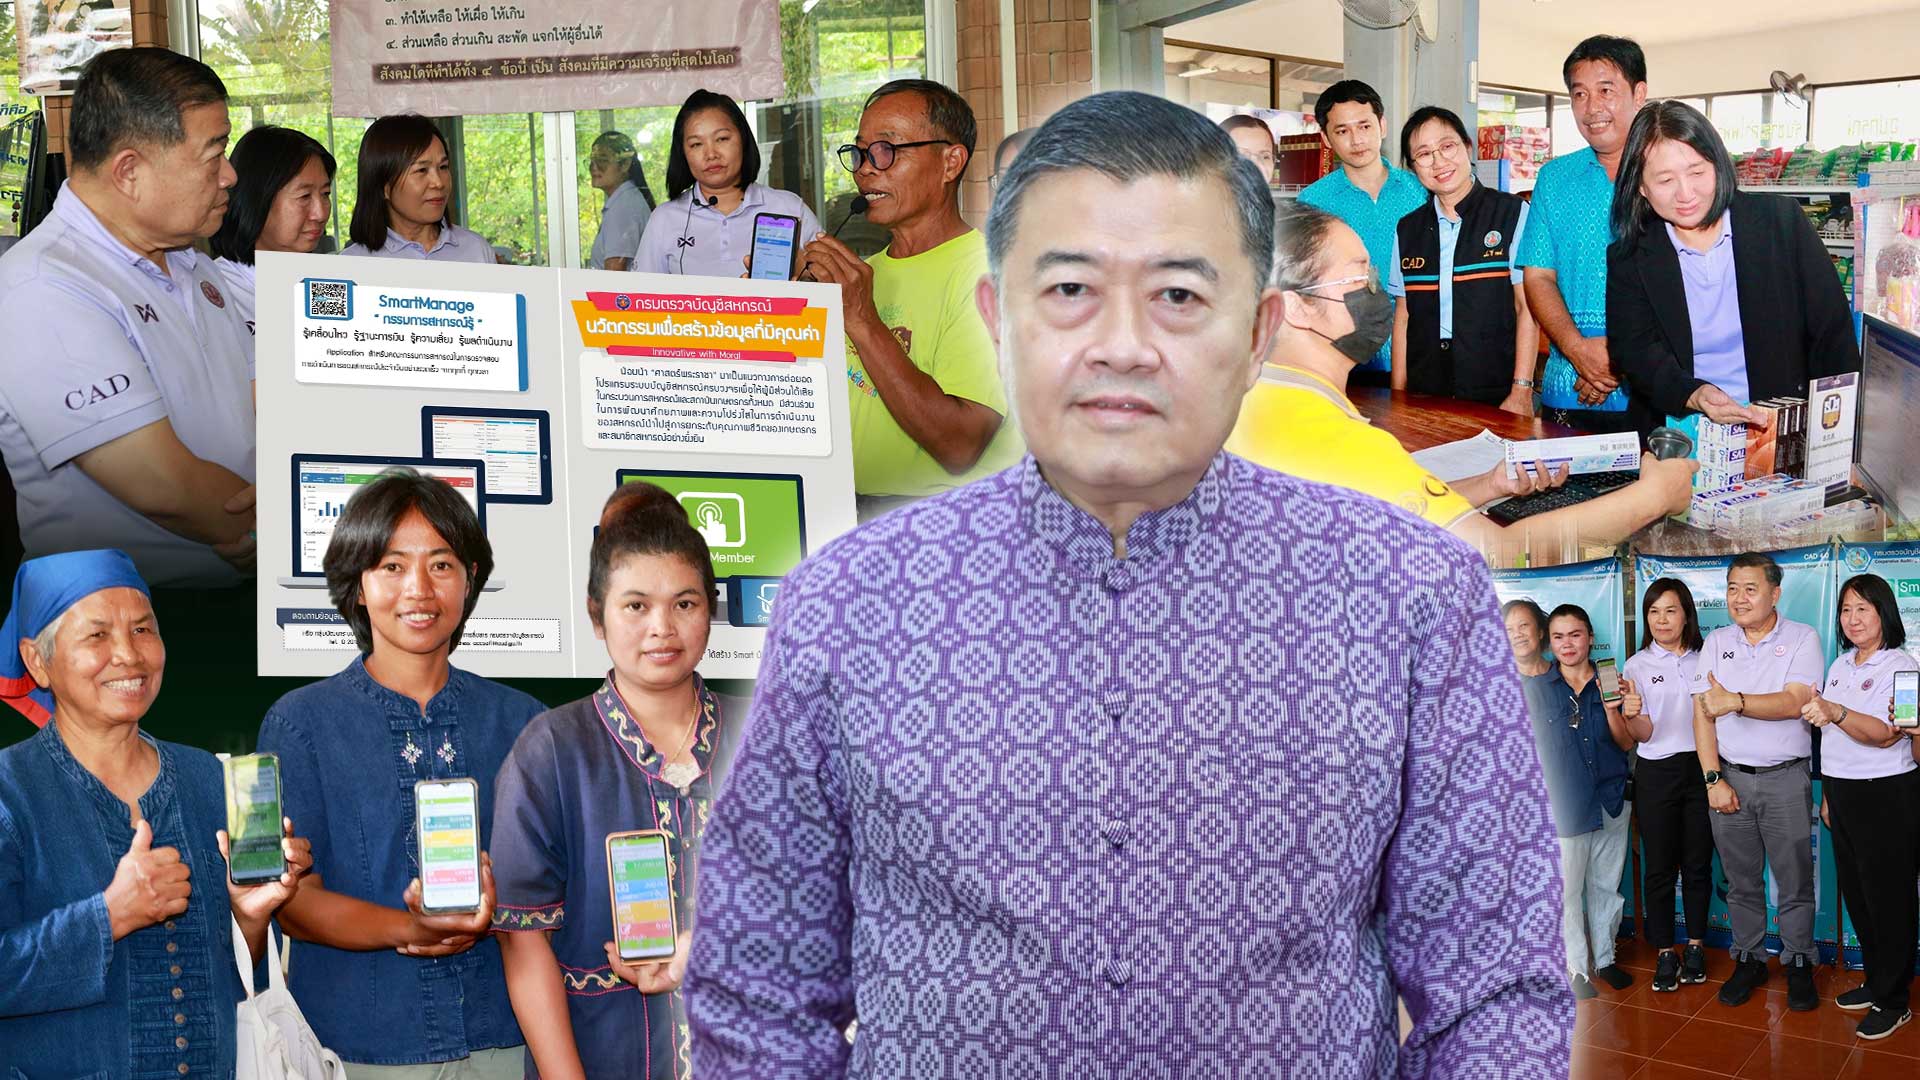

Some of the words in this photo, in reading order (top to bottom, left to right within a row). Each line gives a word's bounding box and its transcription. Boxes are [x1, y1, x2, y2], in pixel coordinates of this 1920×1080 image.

[401, 8, 452, 25] ทำให้เหลือ
[455, 4, 488, 21] ให้เผื่อ
[491, 4, 525, 21] ให้เกิน
[402, 32, 448, 49] ส่วนเหลือ
[452, 29, 493, 47] ส่วนเกิน
[497, 28, 528, 44] สะพัด
[532, 25, 603, 46] แจกให้ผู้อื่นได้
[380, 60, 477, 81] สังคมใดที่ทำได้ทั้ง
[531, 56, 553, 74] เป็น
[559, 51, 735, 73] สังคมที่มีความเจริญที่สุดในโลก
[1401, 257, 1425, 269] CAD
[379, 294, 475, 314] SmartManage
[635, 298, 772, 315] กรมตรวจบัญชีสหกรณ์
[383, 315, 474, 331] กรรมการสหกรณ์รู้
[586, 315, 820, 345] นวัตกรรมเพื่อสร้างข้อมูลที่มีคุณค่า
[303, 326, 348, 340] รู้เคลื่อนไหว
[354, 331, 405, 343] รู้ฐานะการเงิน
[410, 332, 453, 345] รู้ความเสี่ยง
[326, 349, 365, 357] Application
[652, 348, 697, 357] Innovative
[699, 350, 717, 358] with
[719, 351, 741, 360] Moral
[65, 373, 131, 411] CAD
[710, 552, 755, 564] Member
[1900, 581, 1920, 593] Sm
[734, 650, 754, 659] Smart
